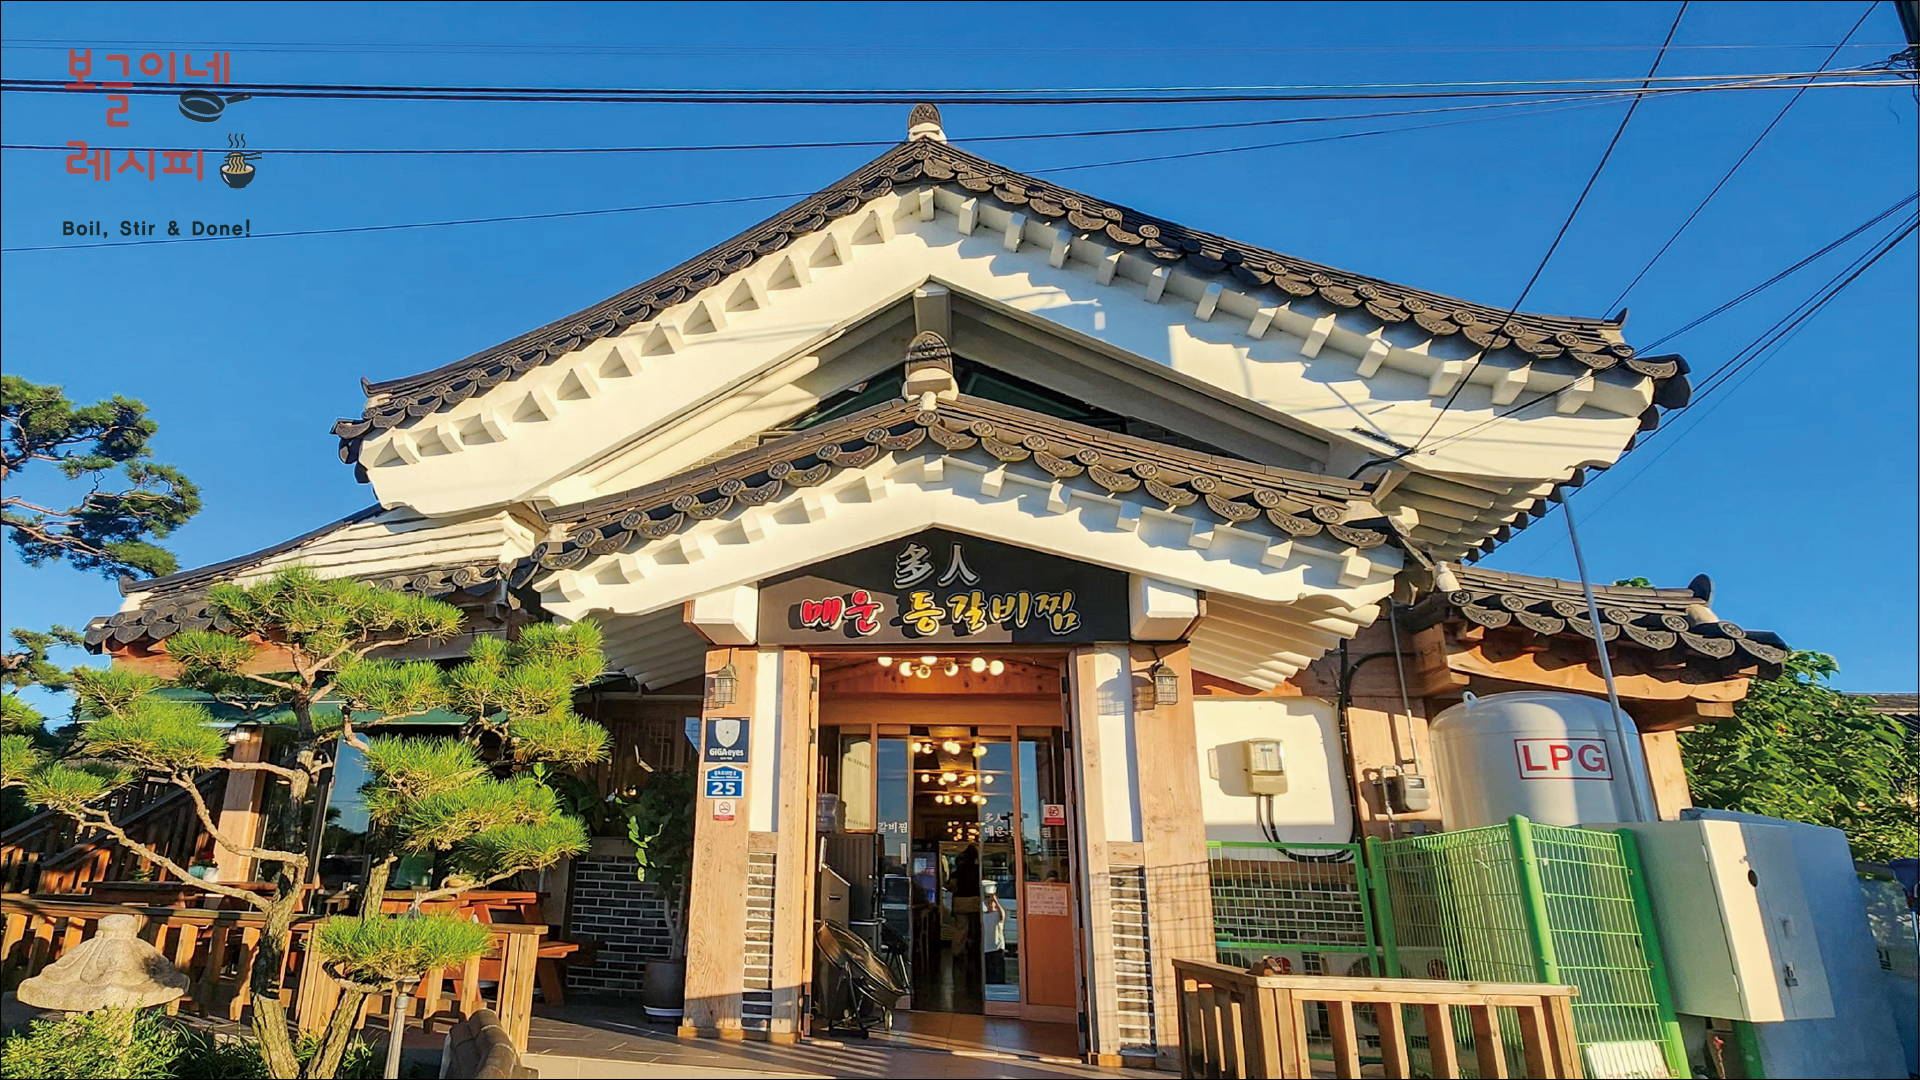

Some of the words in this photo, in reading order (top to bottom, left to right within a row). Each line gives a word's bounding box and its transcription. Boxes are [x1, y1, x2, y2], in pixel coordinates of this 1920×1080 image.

[894, 542, 980, 588] 多人
[800, 590, 884, 635] 매운
[903, 590, 1082, 636] 등갈비찜
[1522, 744, 1606, 772] LPG
[711, 781, 736, 795] 25
